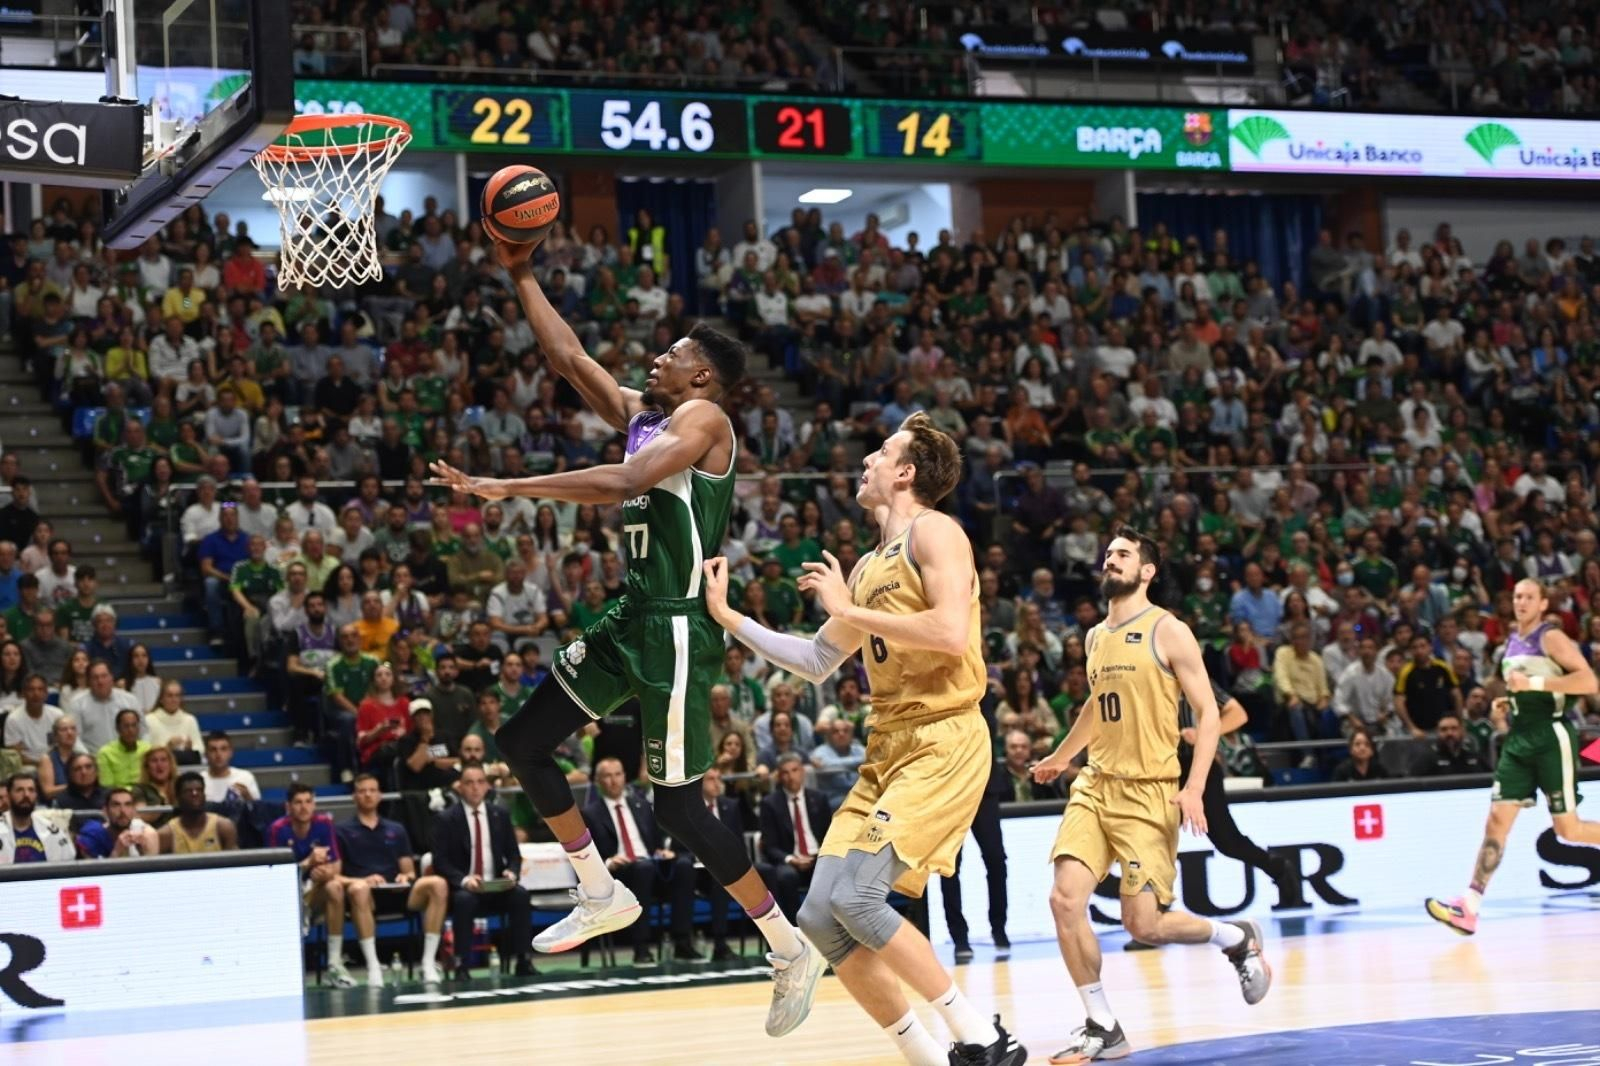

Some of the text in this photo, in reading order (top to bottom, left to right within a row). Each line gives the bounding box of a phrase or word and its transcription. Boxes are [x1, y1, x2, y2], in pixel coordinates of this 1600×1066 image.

[471, 97, 533, 145] 22
[600, 99, 715, 152] 54.6
[777, 107, 825, 149] 21
[897, 111, 951, 157] 14
[0, 118, 87, 166] sa
[1076, 126, 1162, 159] BARÇA
[1288, 141, 1423, 167] Unicaja Banco
[1519, 147, 1588, 172] Unicaja
[623, 523, 649, 559] 77
[1097, 691, 1122, 723] 10
